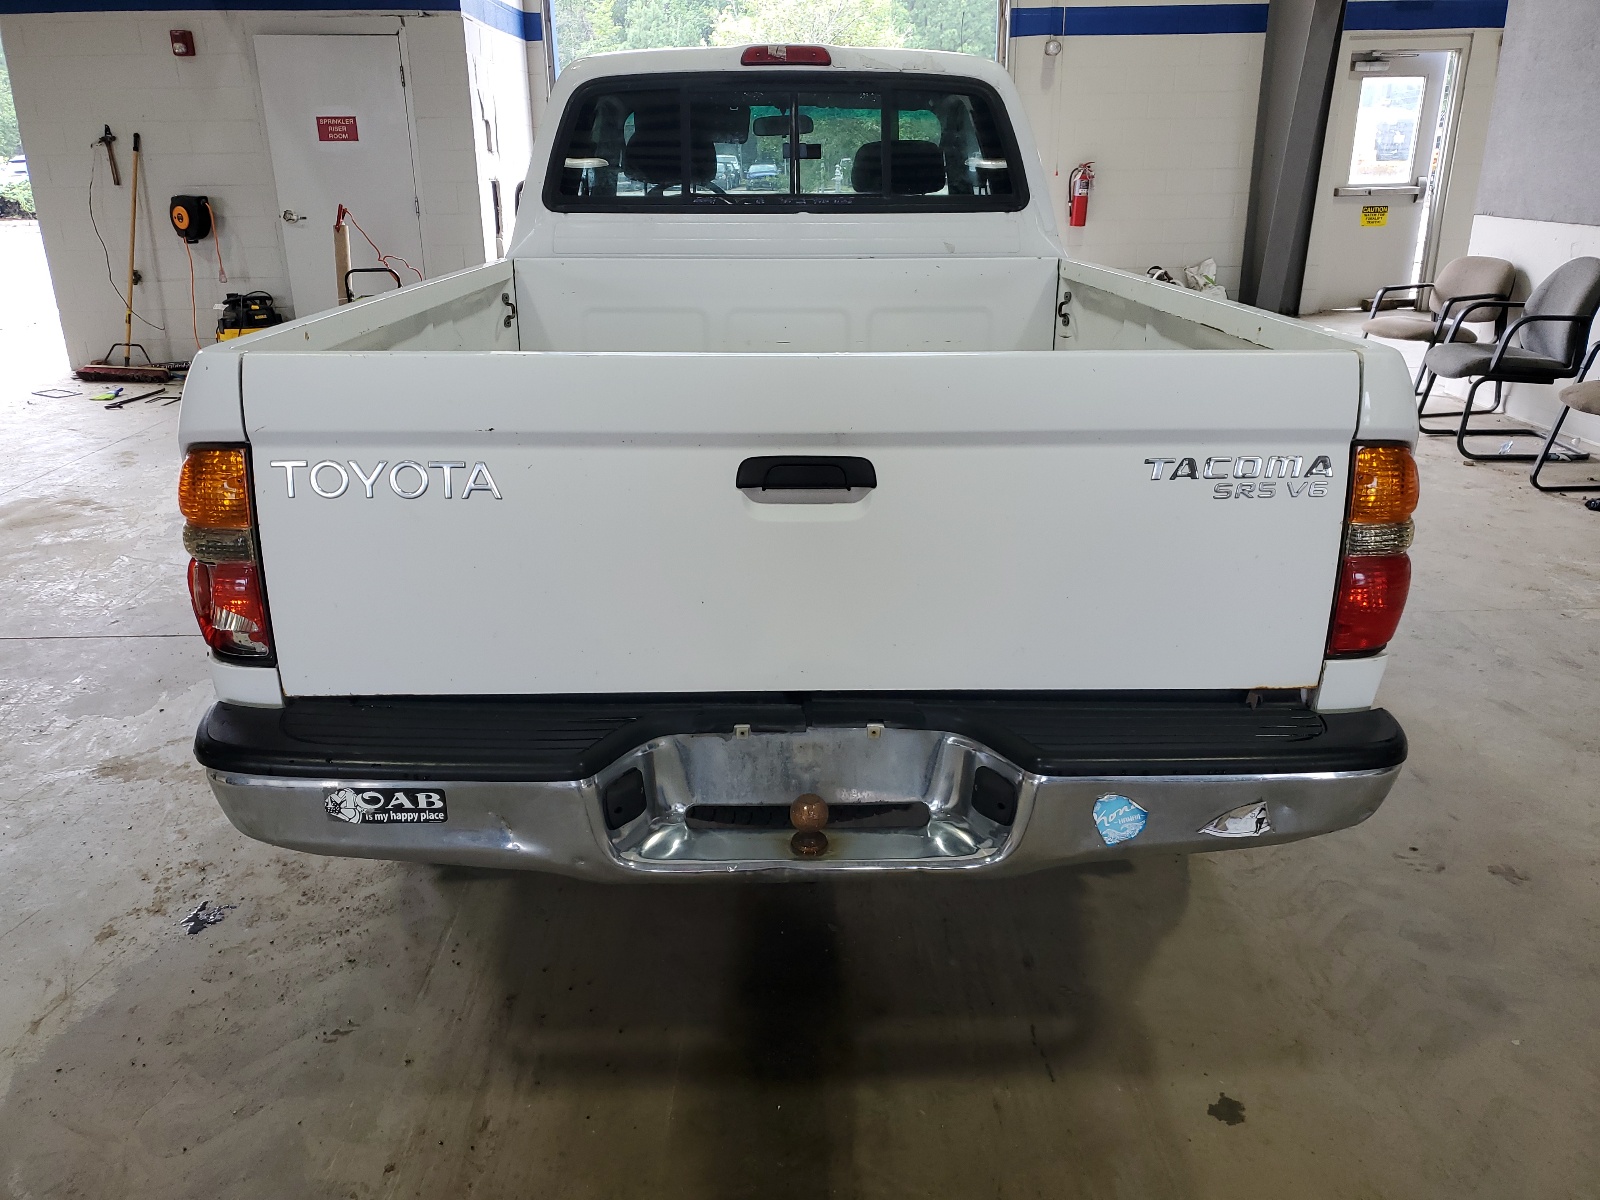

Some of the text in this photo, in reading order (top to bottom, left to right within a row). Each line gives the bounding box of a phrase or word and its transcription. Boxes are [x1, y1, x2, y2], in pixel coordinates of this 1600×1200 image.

[1144, 455, 1334, 480] TACOMA
[270, 460, 503, 500] TOYOTA
[1286, 481, 1329, 498] V6
[374, 813, 388, 822] my
[390, 811, 419, 822] happy
[420, 810, 445, 822] place
